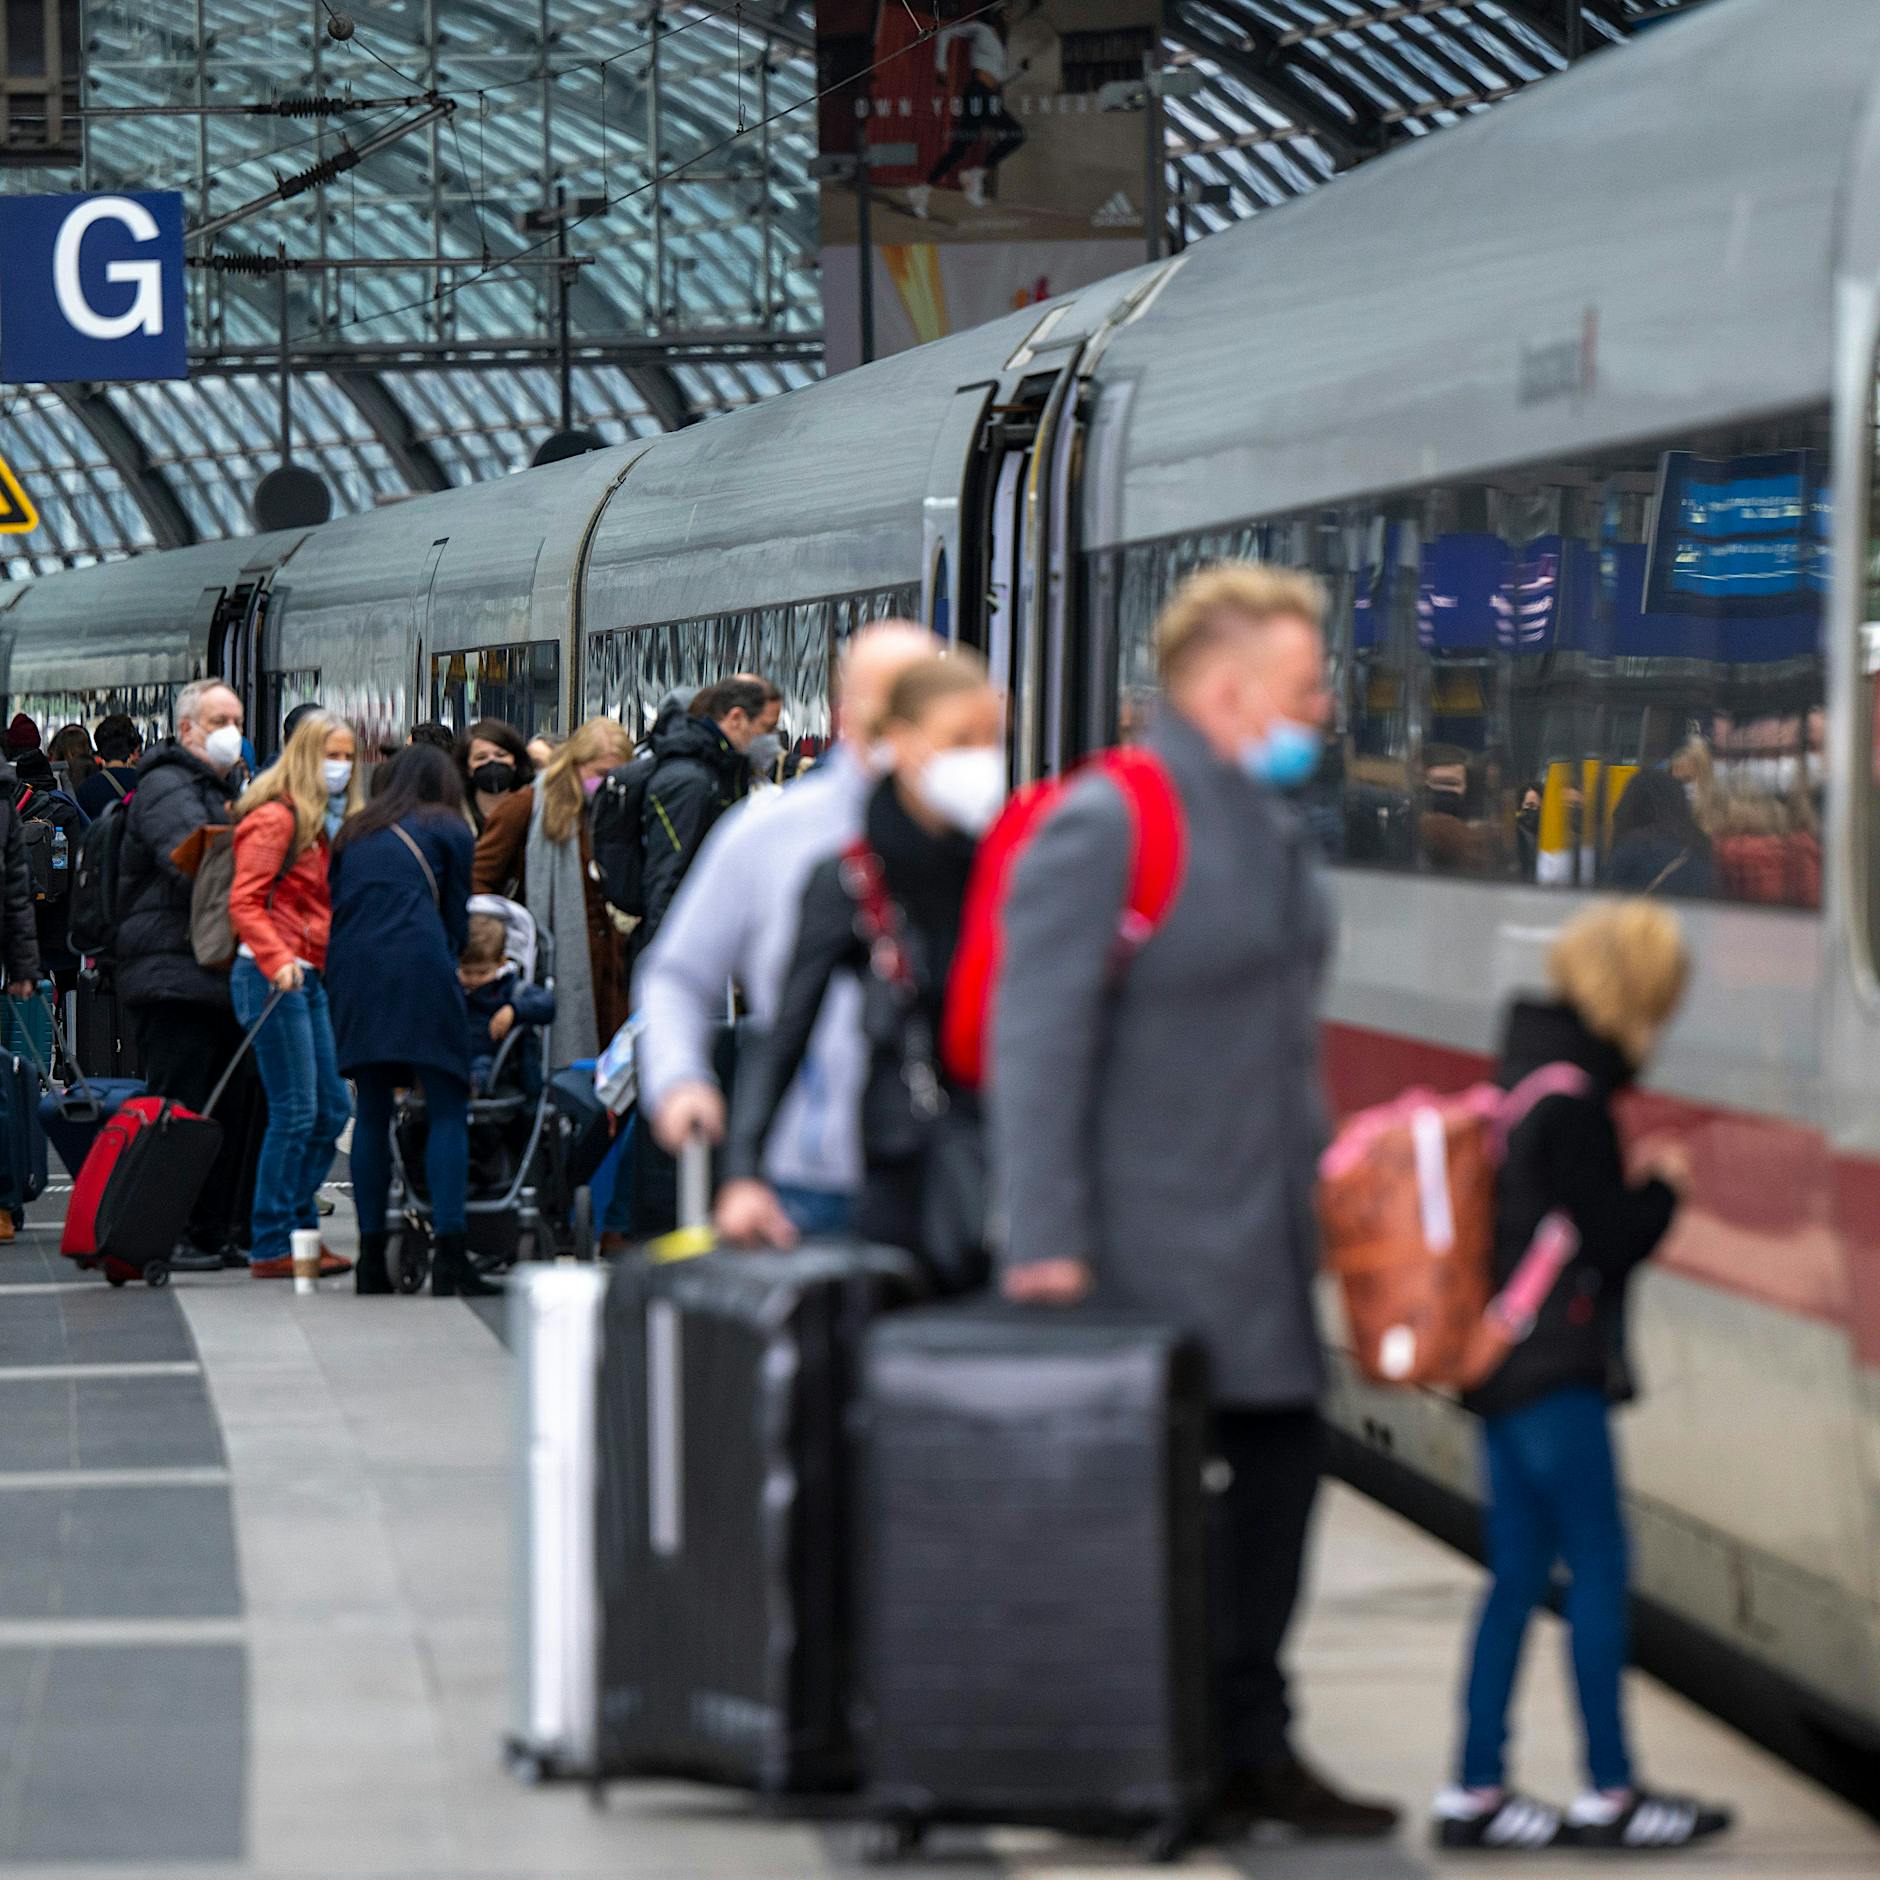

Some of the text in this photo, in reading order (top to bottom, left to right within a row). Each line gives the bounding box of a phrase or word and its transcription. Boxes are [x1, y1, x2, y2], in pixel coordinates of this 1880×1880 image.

[855, 96, 912, 118] OWN
[932, 95, 1000, 117] YOUR
[53, 195, 163, 340] G
